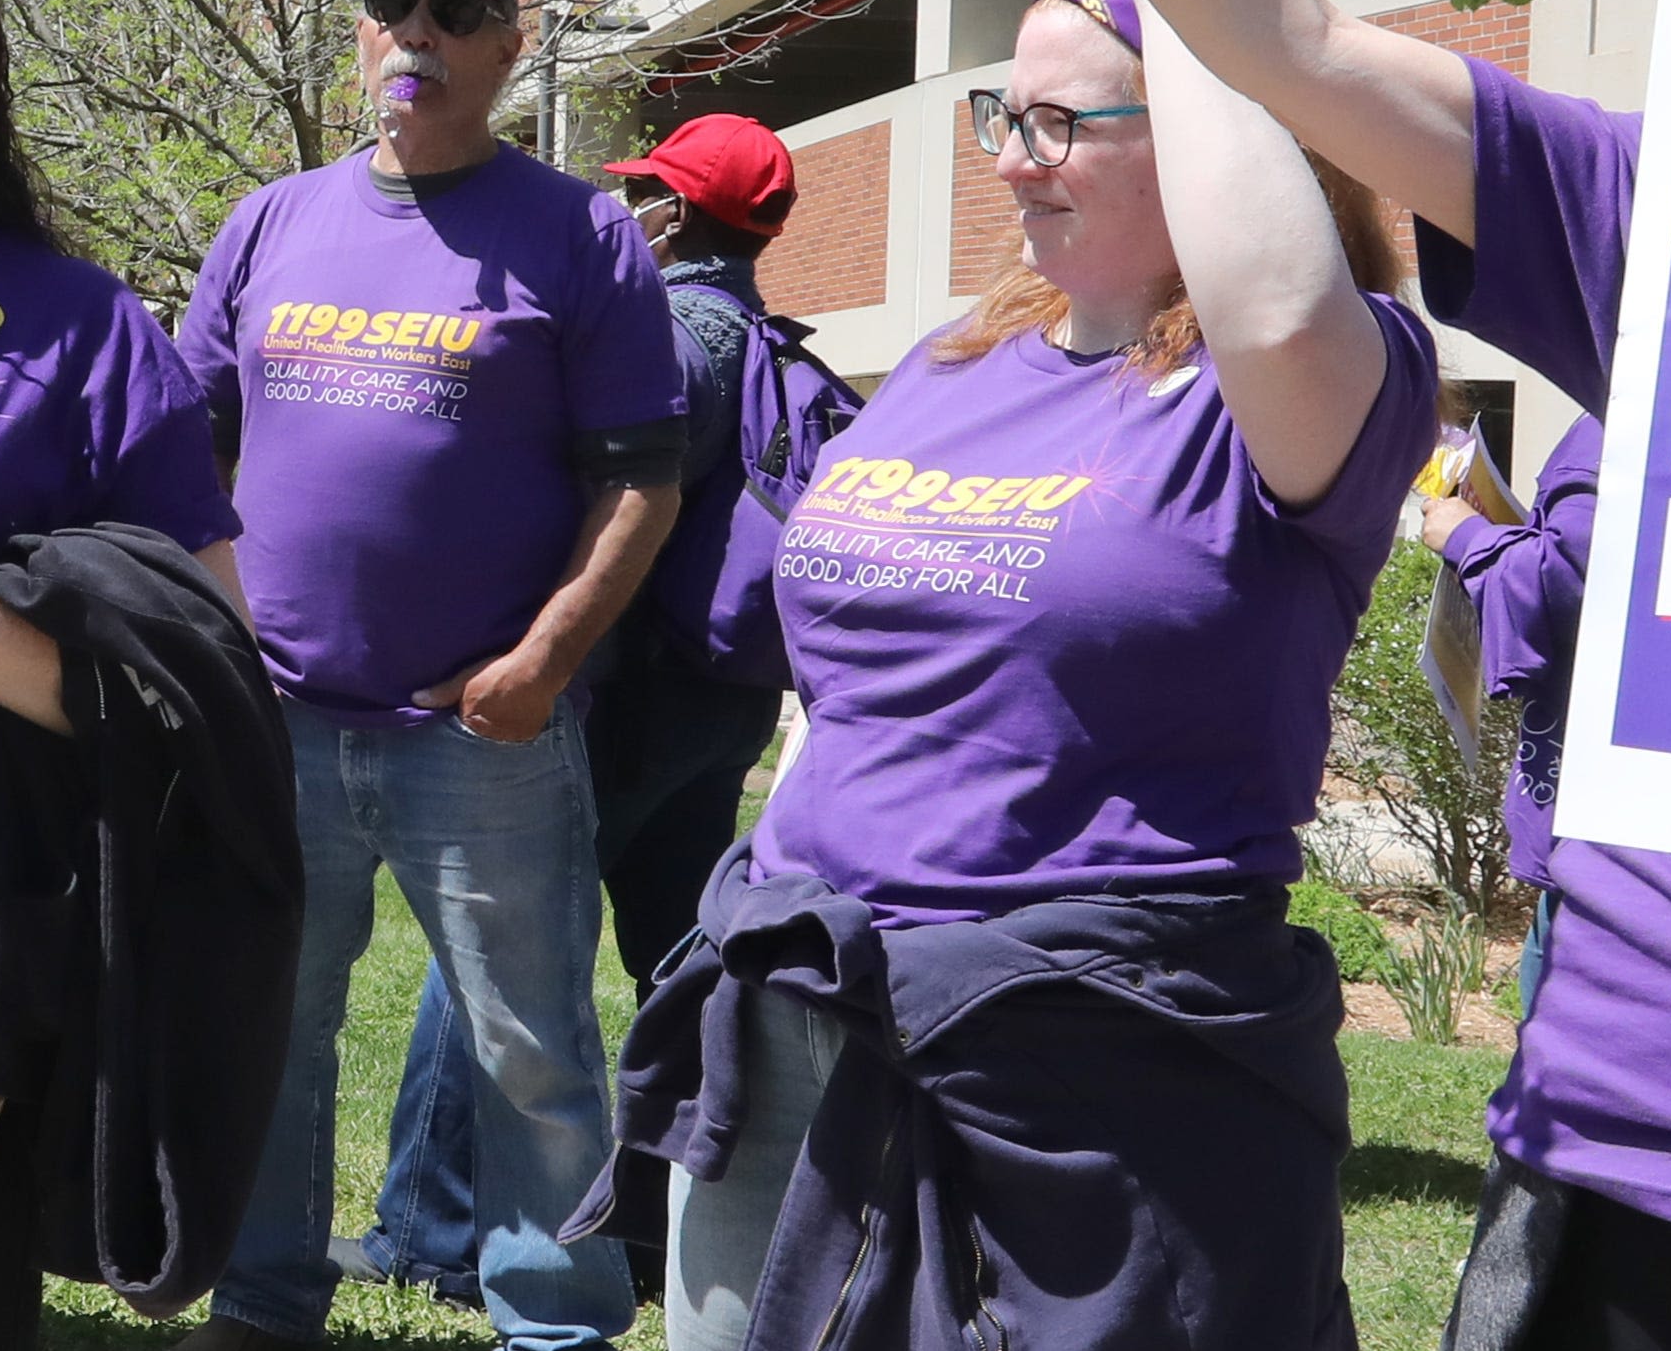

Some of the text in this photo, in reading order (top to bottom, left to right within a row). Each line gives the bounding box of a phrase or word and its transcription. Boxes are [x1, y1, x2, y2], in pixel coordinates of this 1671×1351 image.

[266, 301, 481, 353] 1199SEIU
[264, 335, 471, 371] United Healthcare Workers East
[264, 361, 468, 400] QUALITY CARE AND
[264, 382, 462, 421] GOOD JOBS FOR ALL
[814, 456, 1092, 515] 1199SEIU
[802, 493, 1060, 532] United Healthcare Workers East
[784, 524, 1045, 569] QUALITY CARE AND
[778, 553, 1031, 602] GOOD JOBS FOR ALL
